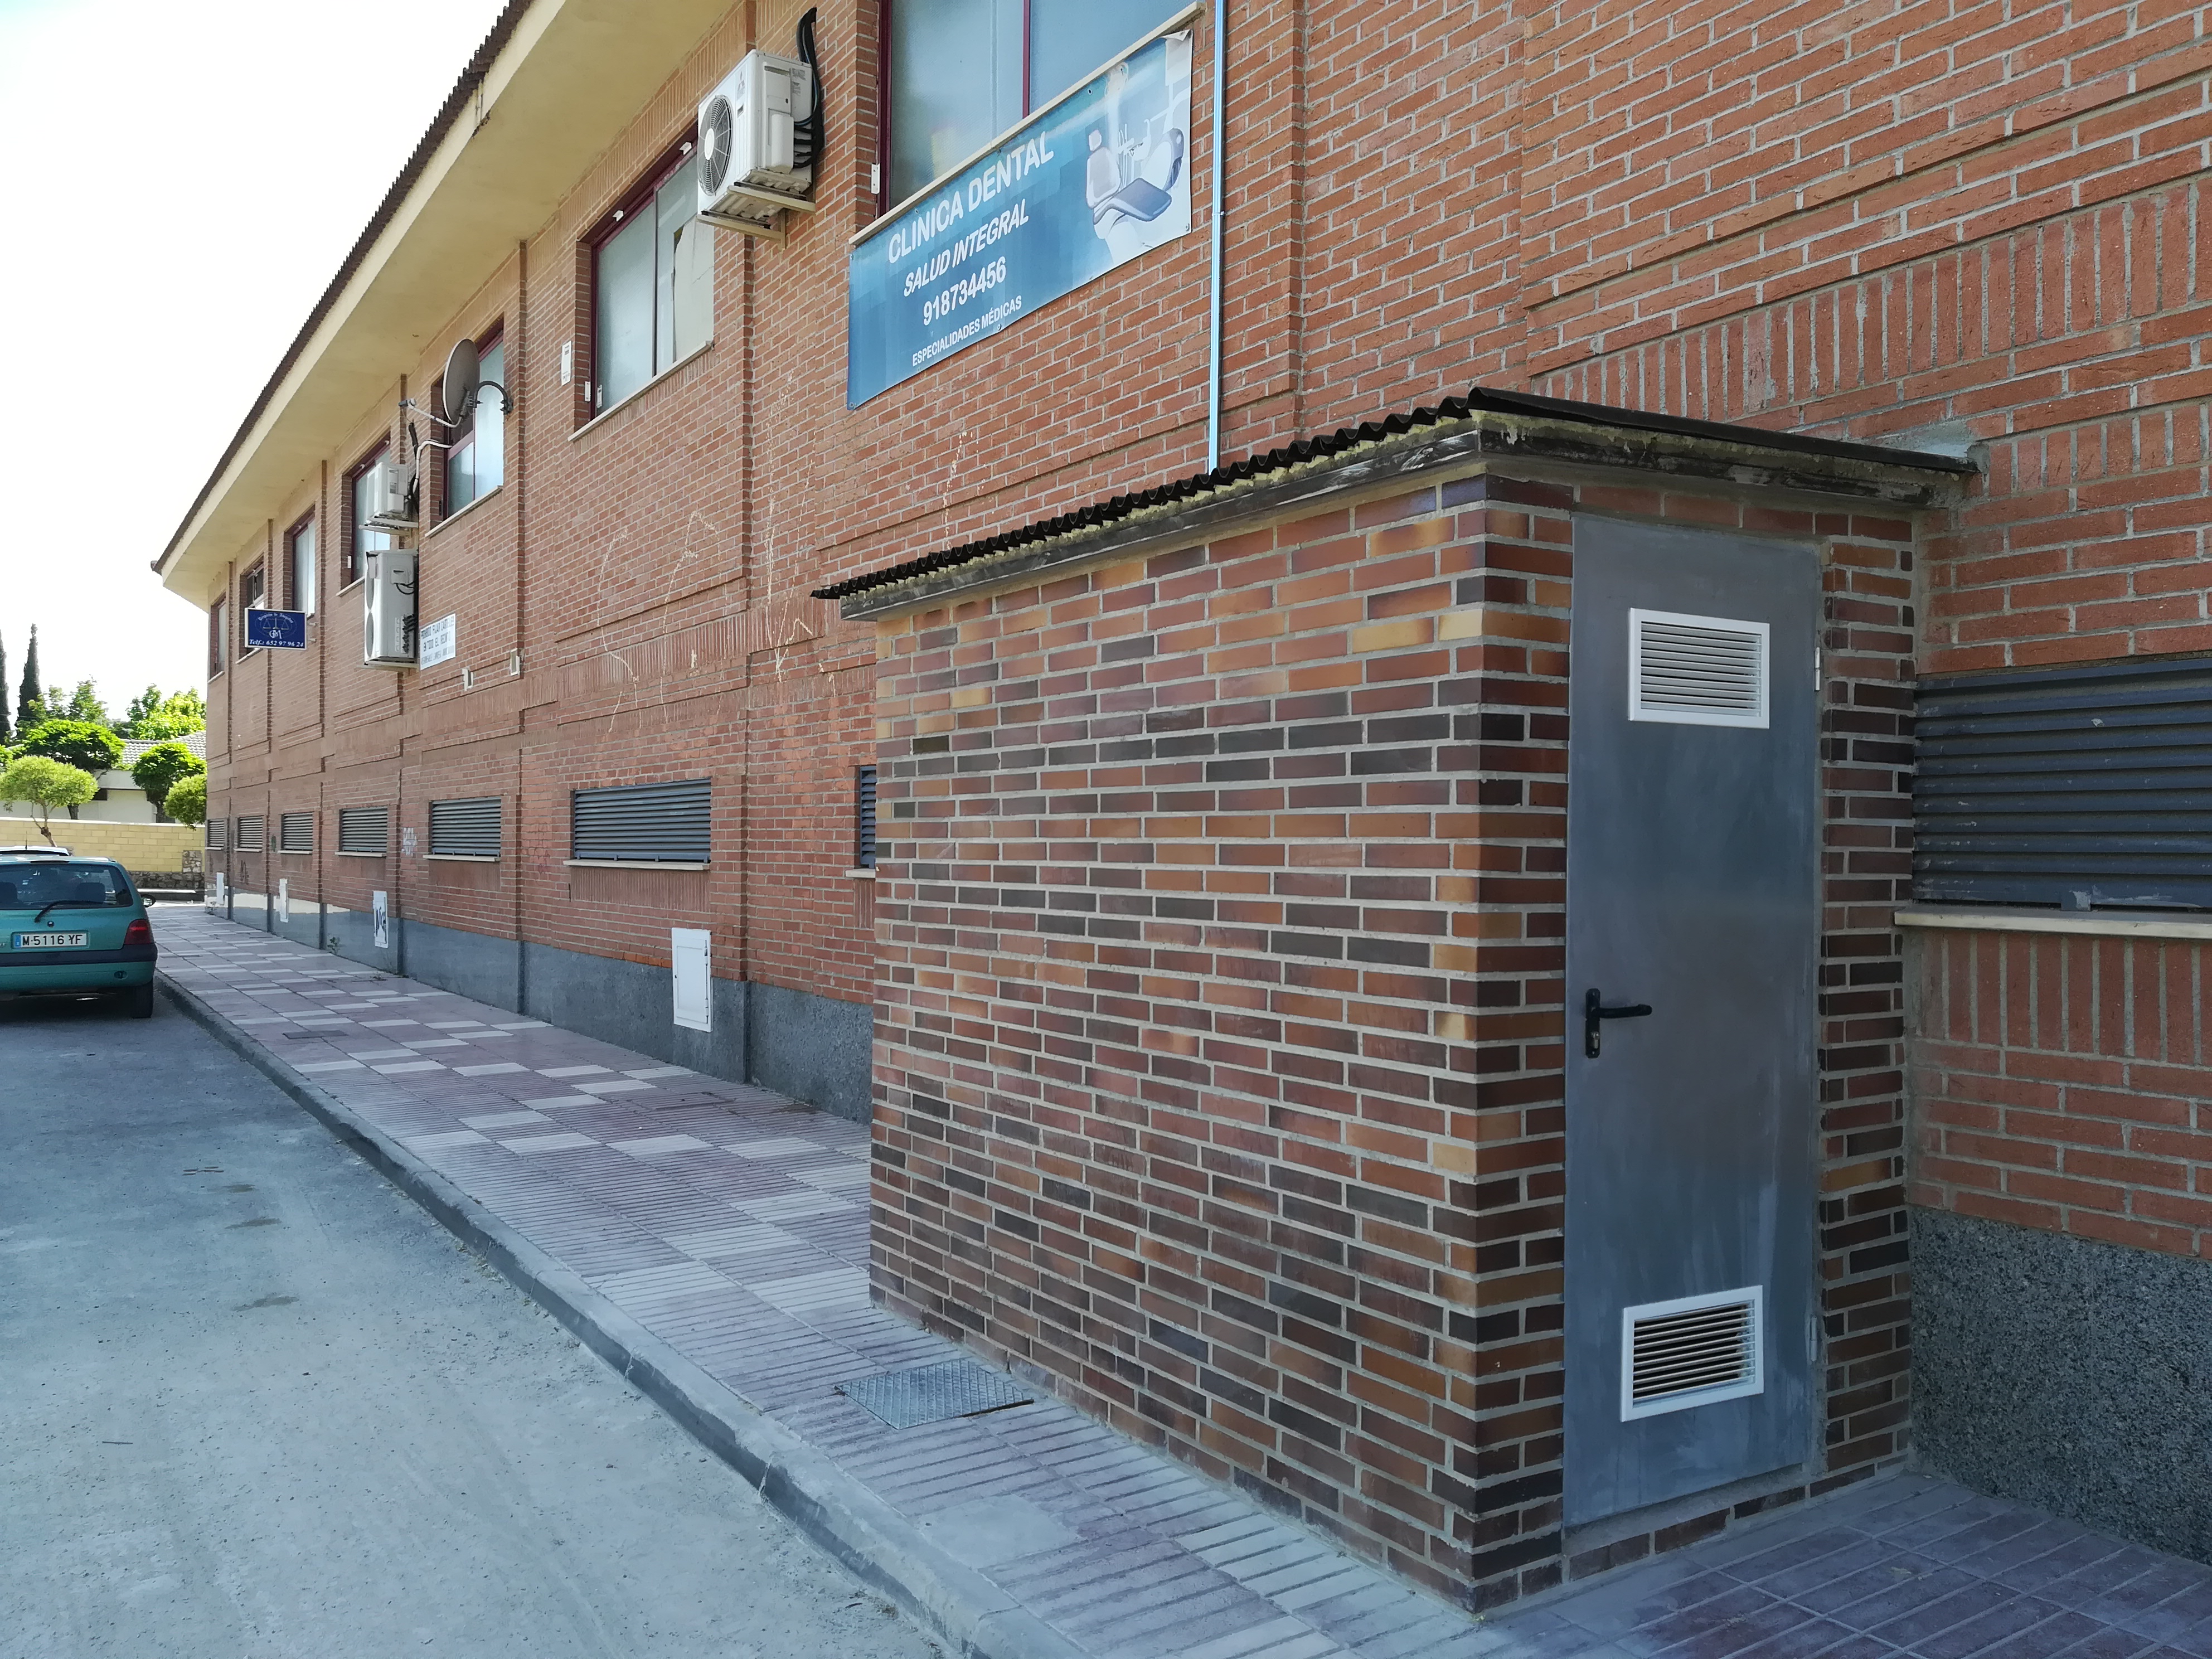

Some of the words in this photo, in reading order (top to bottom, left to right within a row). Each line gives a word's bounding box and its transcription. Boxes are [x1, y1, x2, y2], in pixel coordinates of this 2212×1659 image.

[889, 191, 963, 263] CLINICA
[968, 131, 1054, 212] DENTAL
[904, 249, 950, 297] SALUD
[952, 198, 1029, 268] INTEGRAL
[912, 318, 980, 367] ESPECIALIDADES
[981, 295, 1022, 329] MÉDICAS
[923, 256, 1006, 326] 918734456
